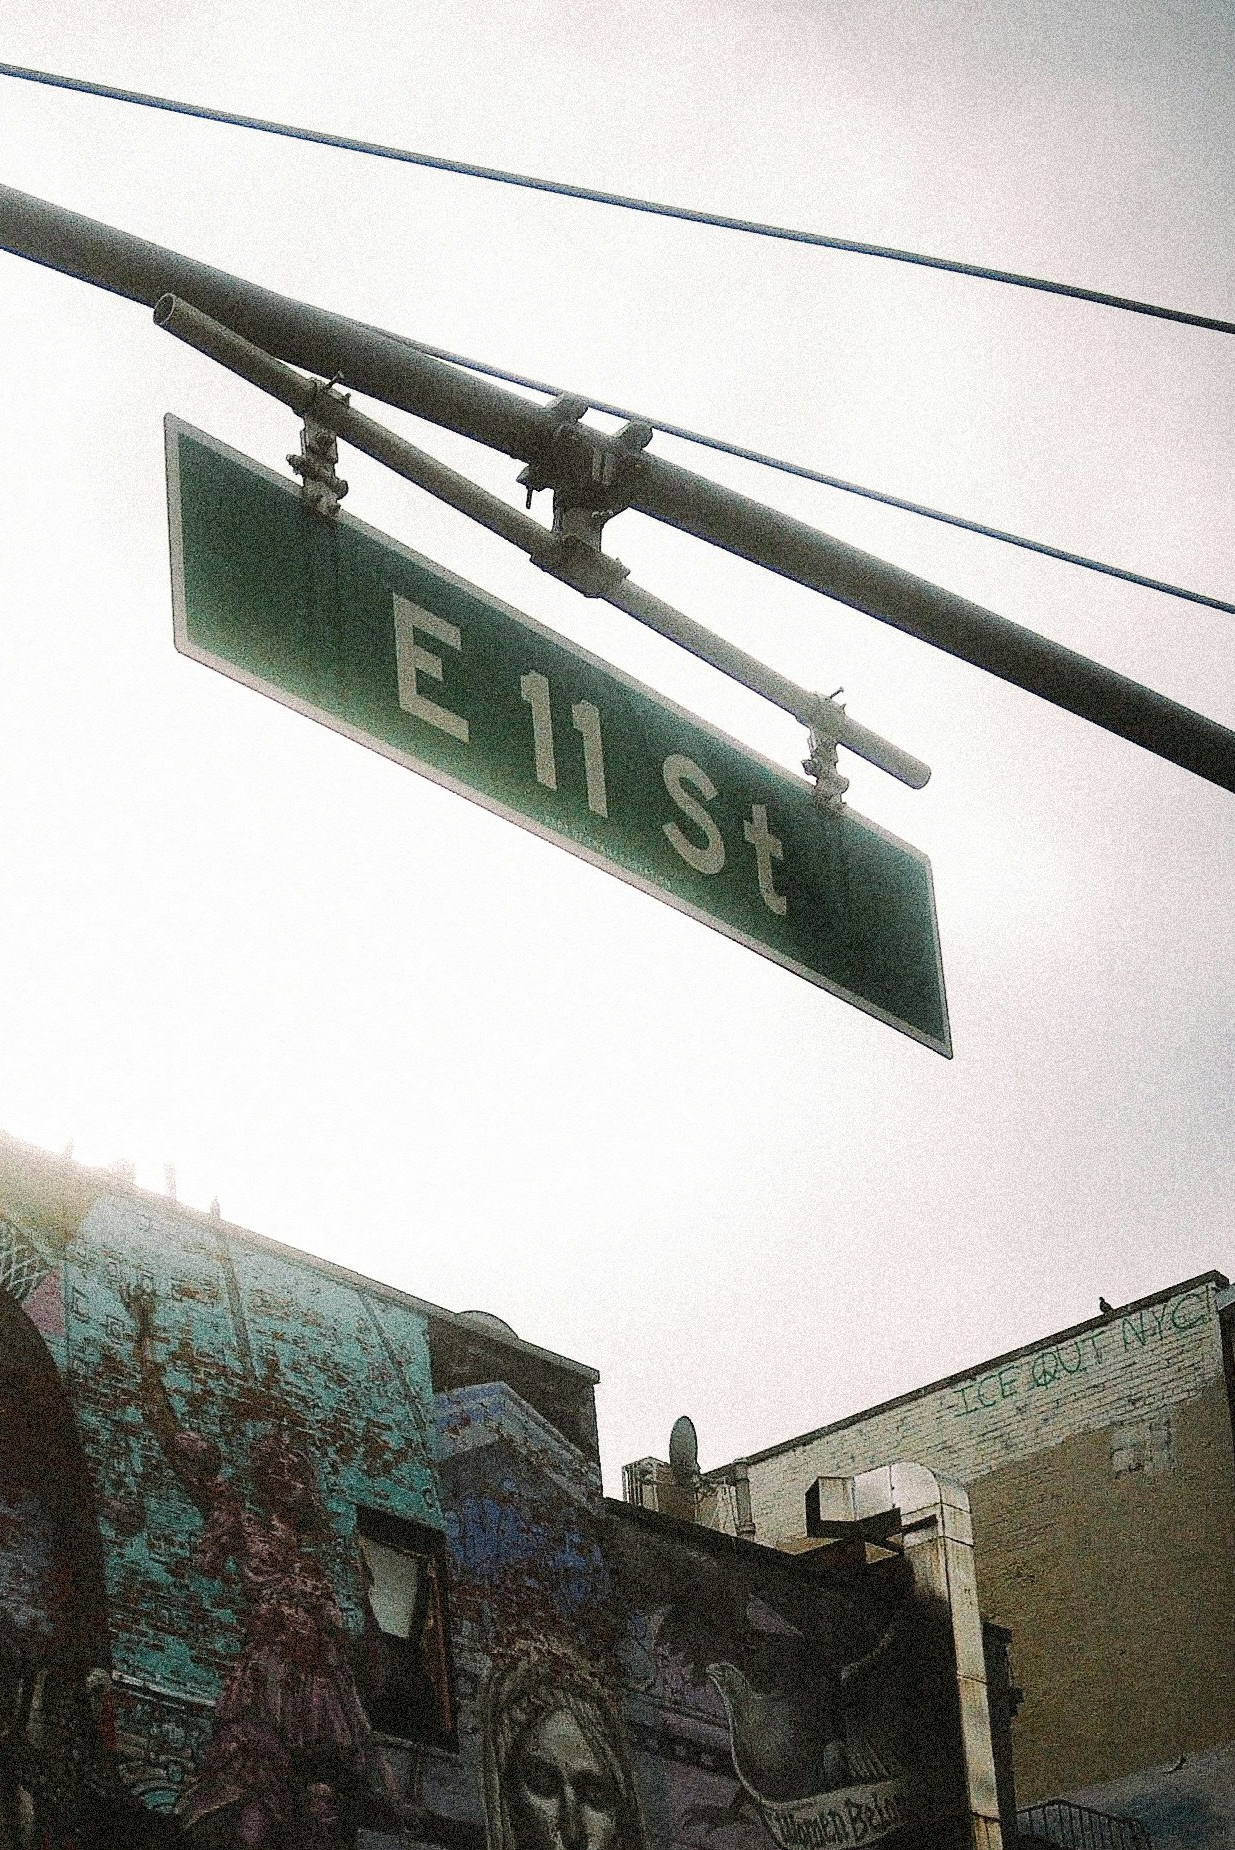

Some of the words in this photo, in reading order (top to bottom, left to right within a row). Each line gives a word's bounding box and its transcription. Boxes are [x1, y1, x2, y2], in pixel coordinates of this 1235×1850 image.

[392, 592, 470, 744] E
[519, 669, 608, 819] 11
[662, 753, 788, 916] St
[953, 1365, 1021, 1418] ICE
